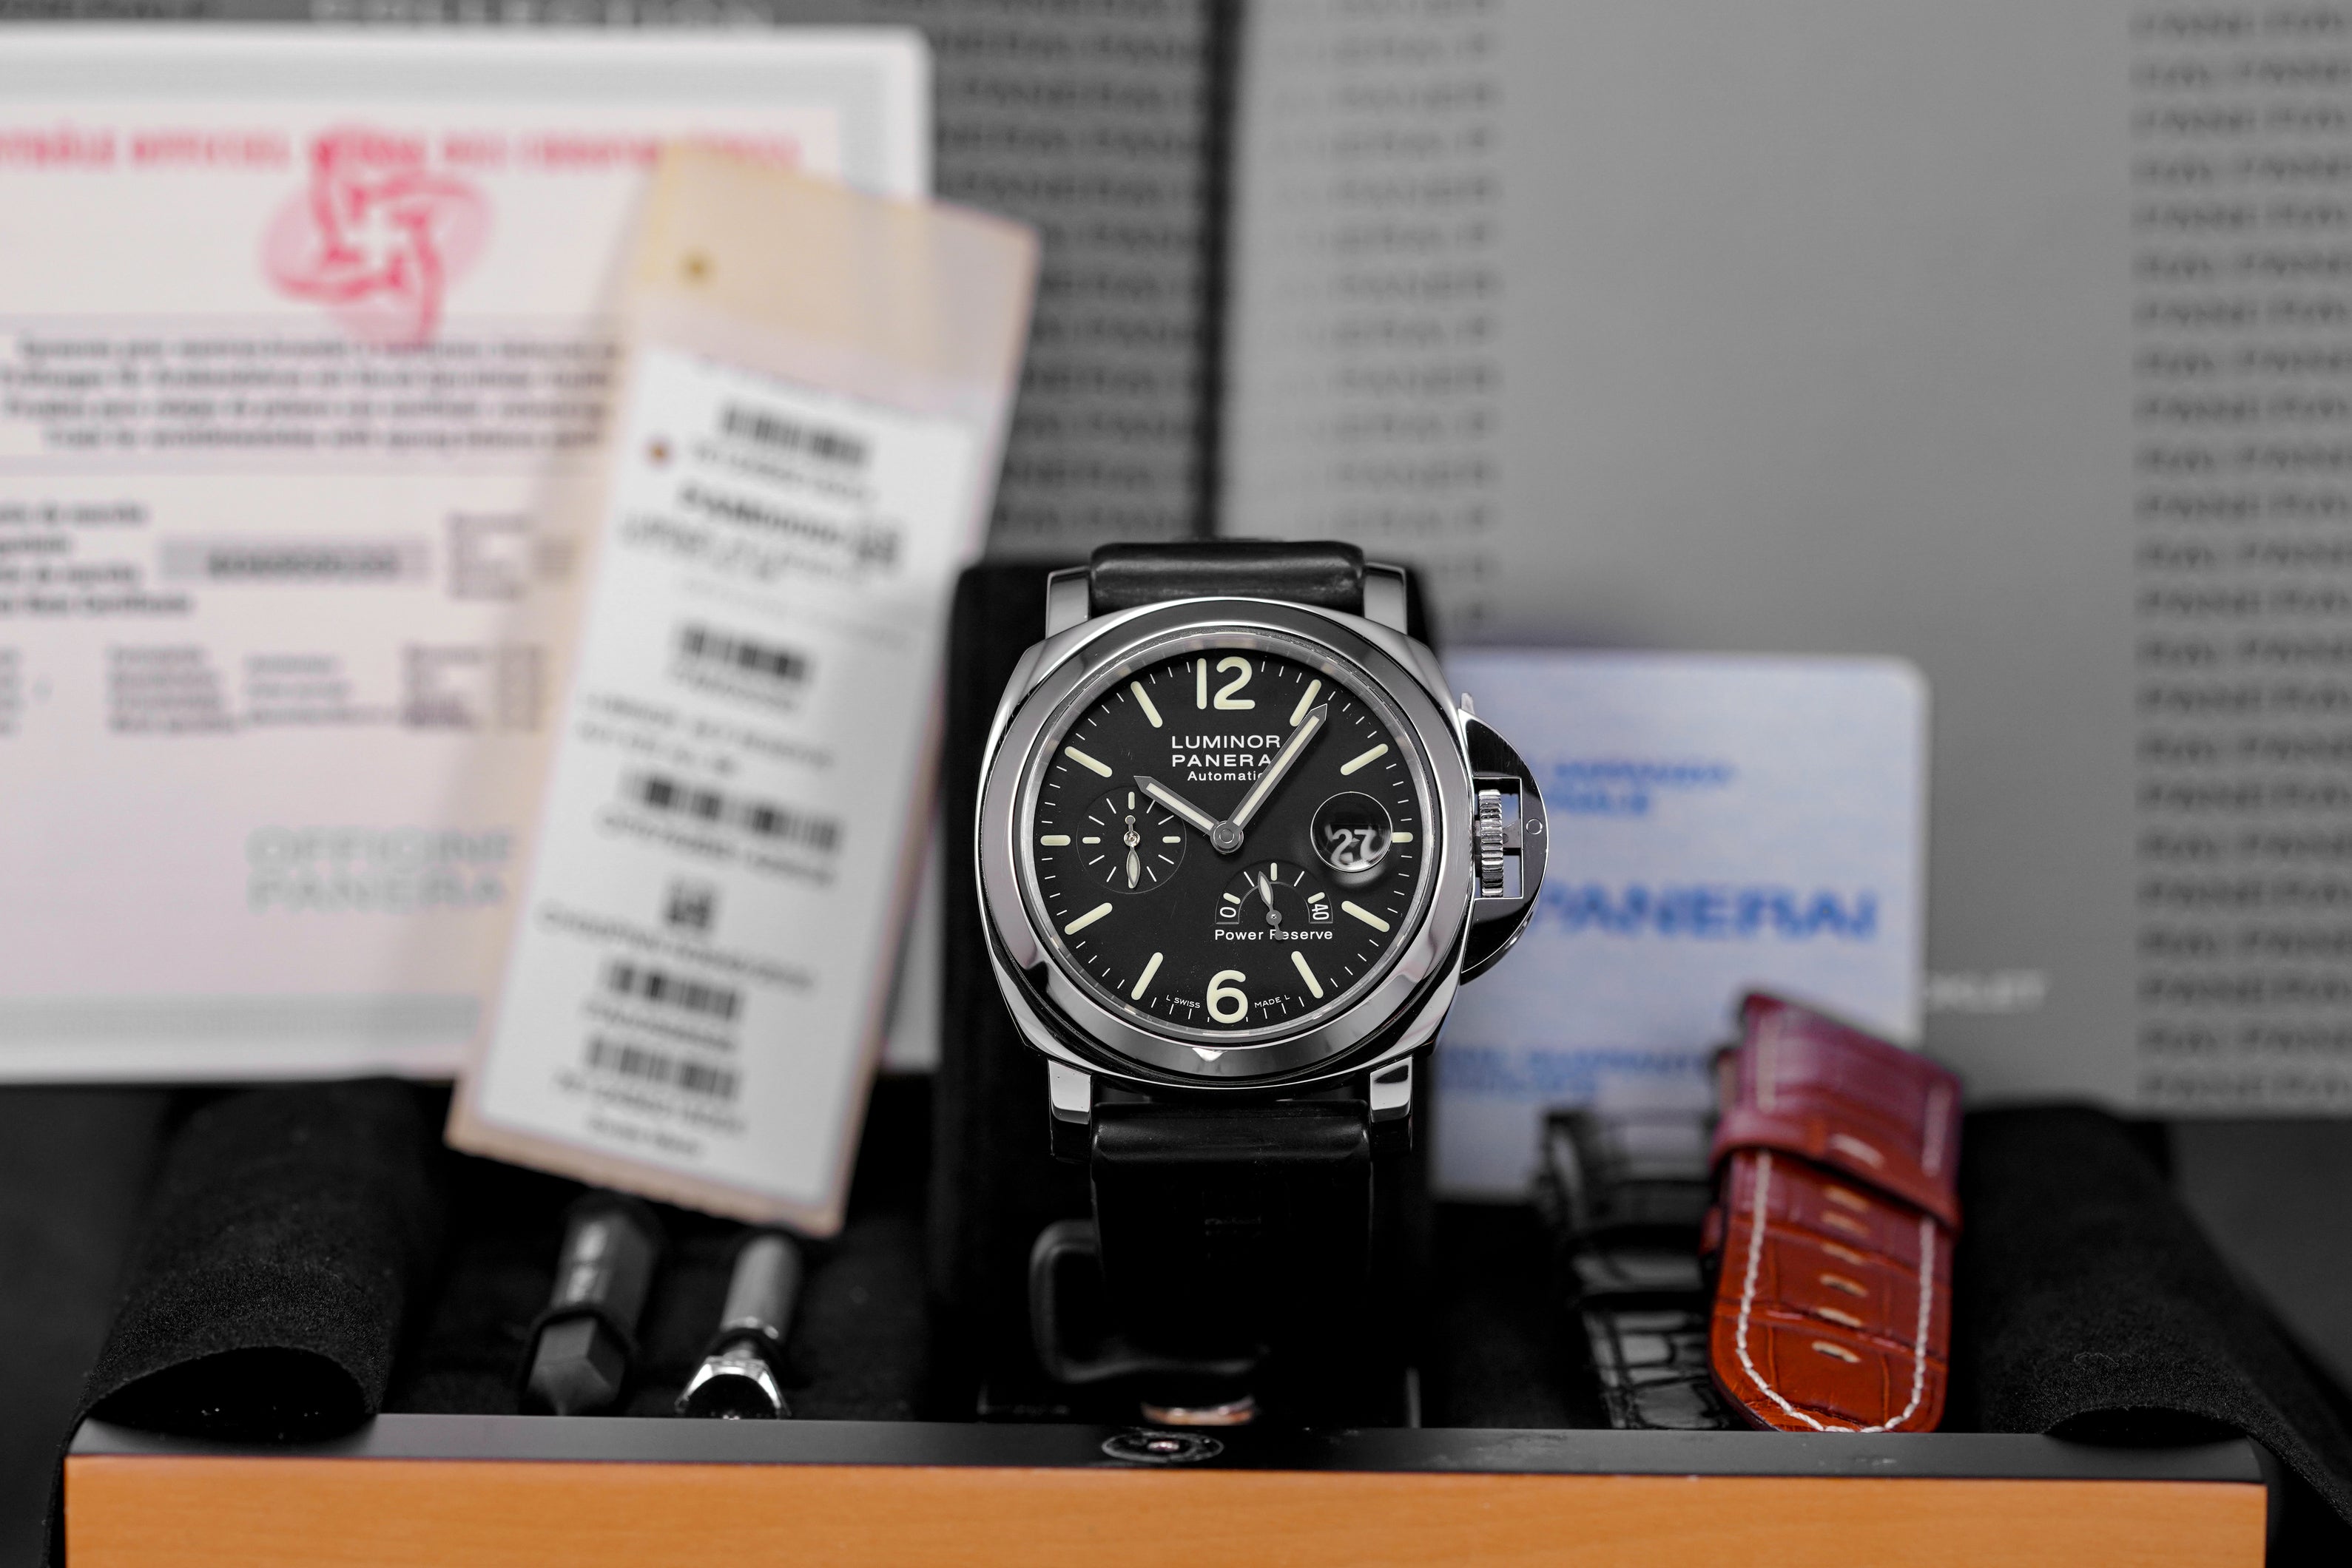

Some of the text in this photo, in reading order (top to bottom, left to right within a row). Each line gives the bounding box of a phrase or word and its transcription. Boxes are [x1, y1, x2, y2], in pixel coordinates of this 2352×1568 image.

[1196, 656, 1256, 710] 12
[1171, 734, 1281, 749] LUMINOR
[1172, 754, 1273, 767] PANERA
[1331, 828, 1377, 868] 27
[1311, 903, 1330, 920] 40
[1215, 930, 1264, 940] Power
[1173, 998, 1201, 1008] SWISS
[1254, 996, 1281, 1008] MADE
[1207, 970, 1248, 1024] 6
